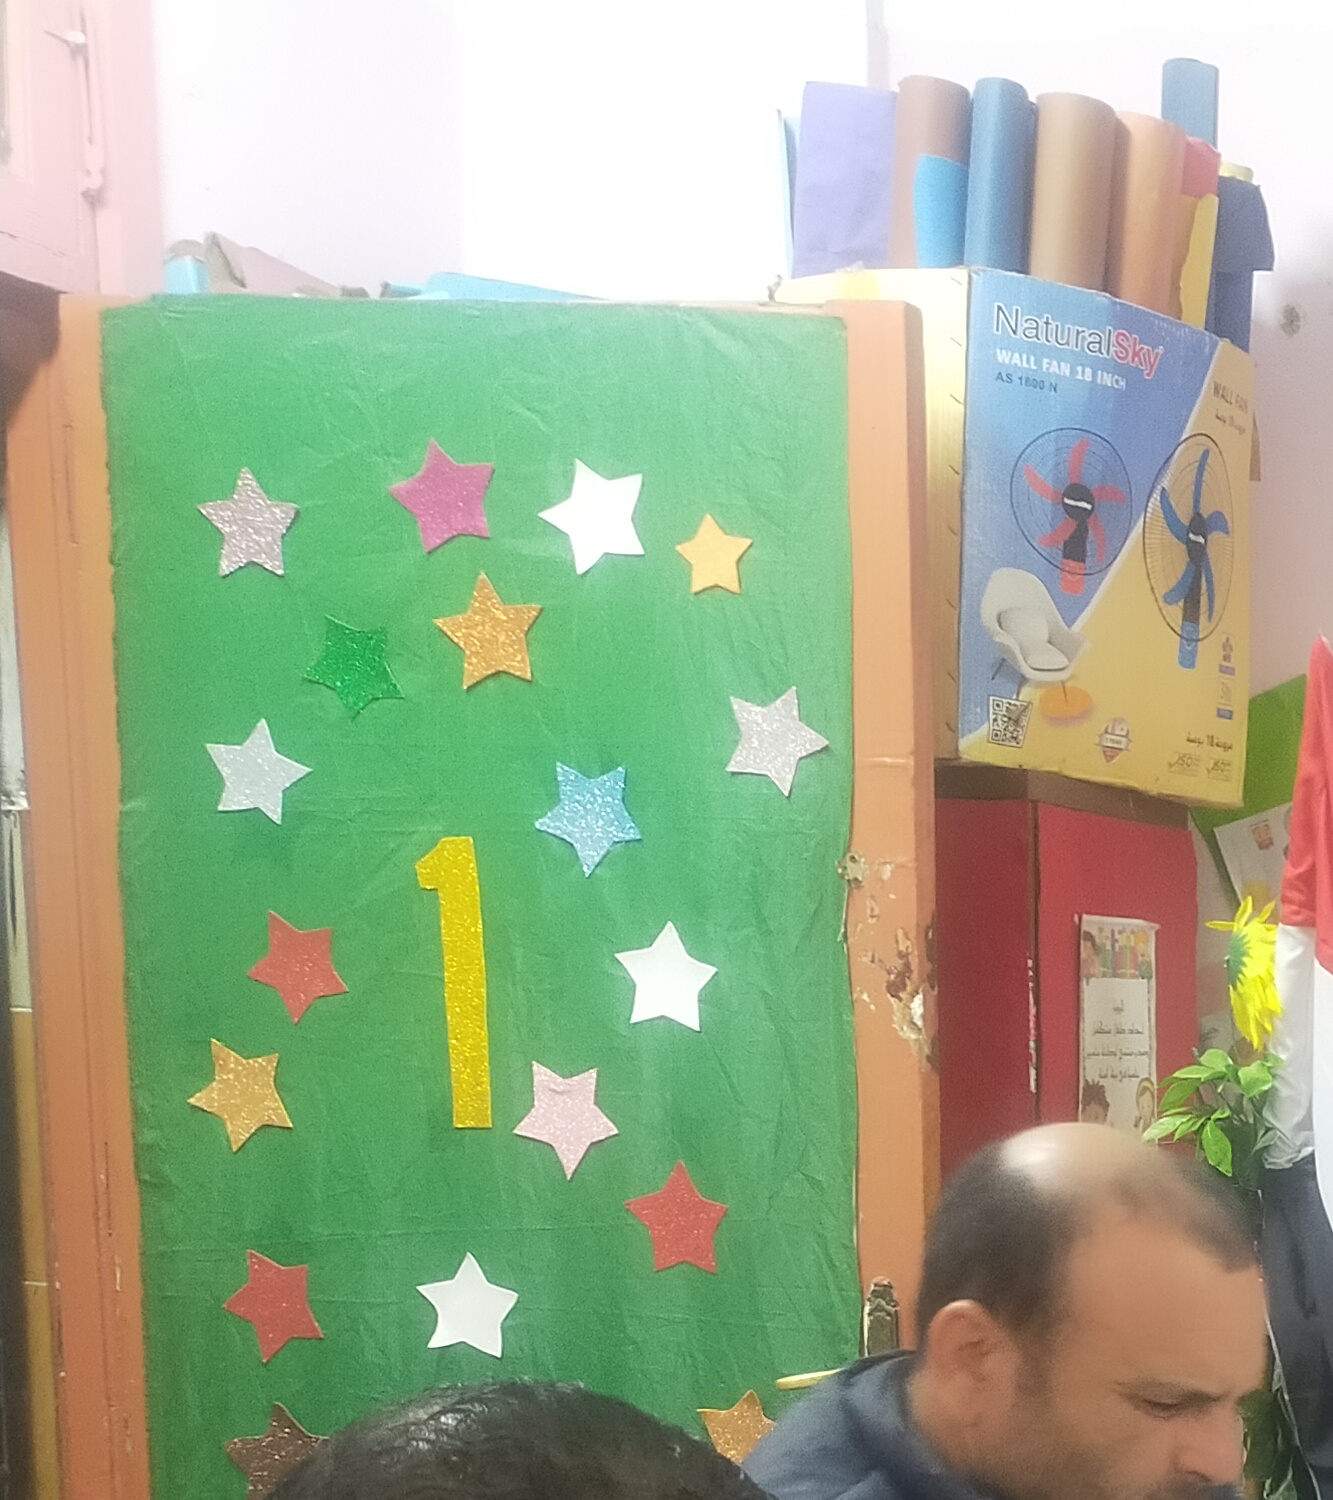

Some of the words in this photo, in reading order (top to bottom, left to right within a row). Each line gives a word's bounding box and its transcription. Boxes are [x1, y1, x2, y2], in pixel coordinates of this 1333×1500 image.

[994, 302, 1163, 380] NaturalSky
[997, 349, 1037, 371] WALL
[1043, 359, 1070, 378] FAN
[1075, 365, 1092, 382] 18
[1097, 371, 1126, 391] INCH
[995, 372, 1013, 384] AS
[415, 836, 493, 1130] 1
